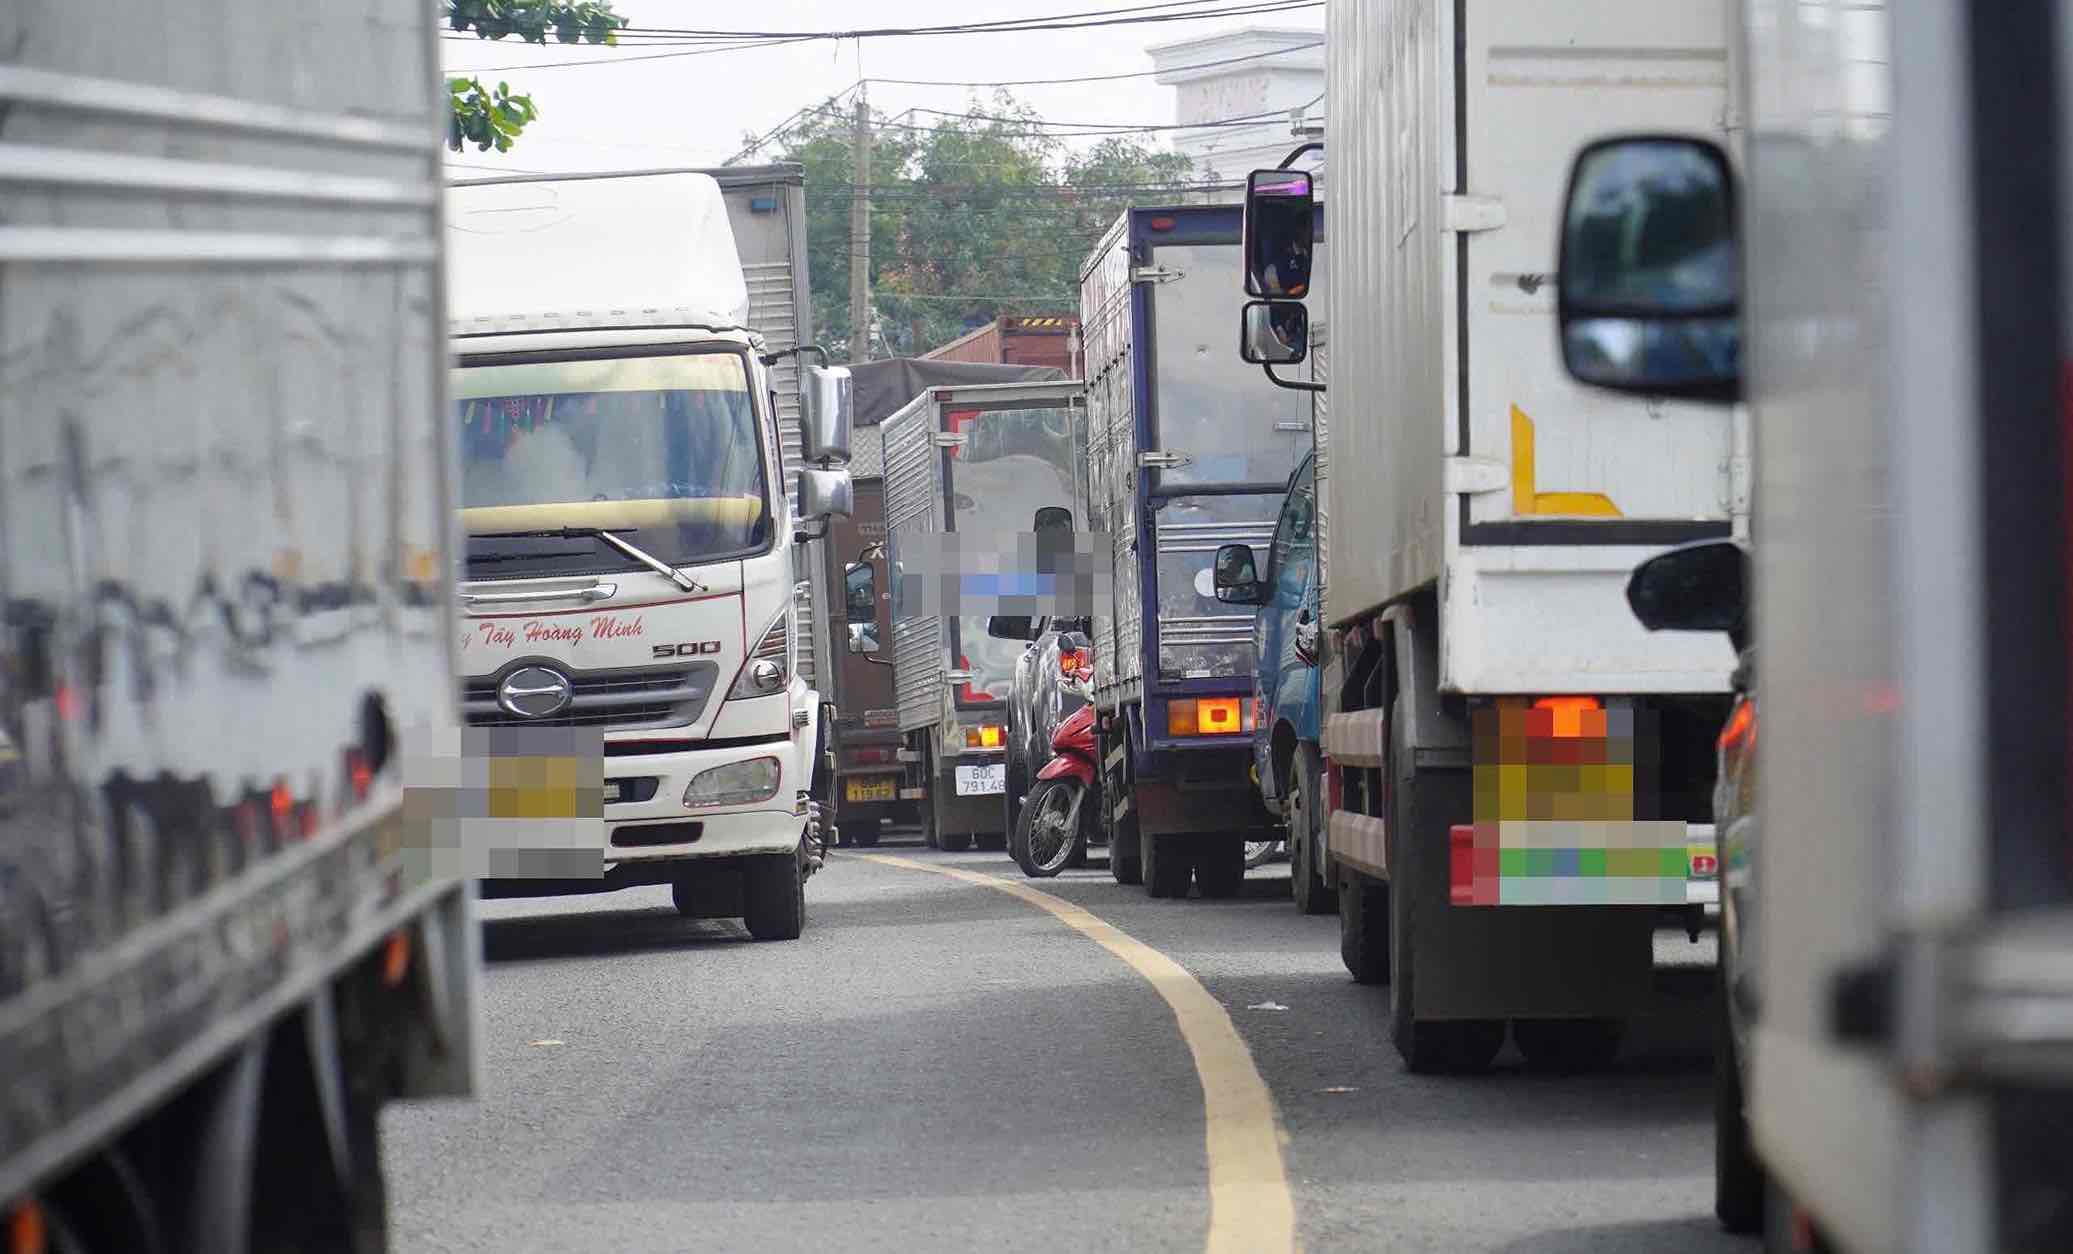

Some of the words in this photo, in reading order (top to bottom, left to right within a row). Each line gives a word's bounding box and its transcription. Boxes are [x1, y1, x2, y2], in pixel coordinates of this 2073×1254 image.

[523, 621, 584, 646] Hoàng
[591, 616, 642, 638] Minh
[653, 641, 720, 659] 500
[972, 767, 994, 780] 60C
